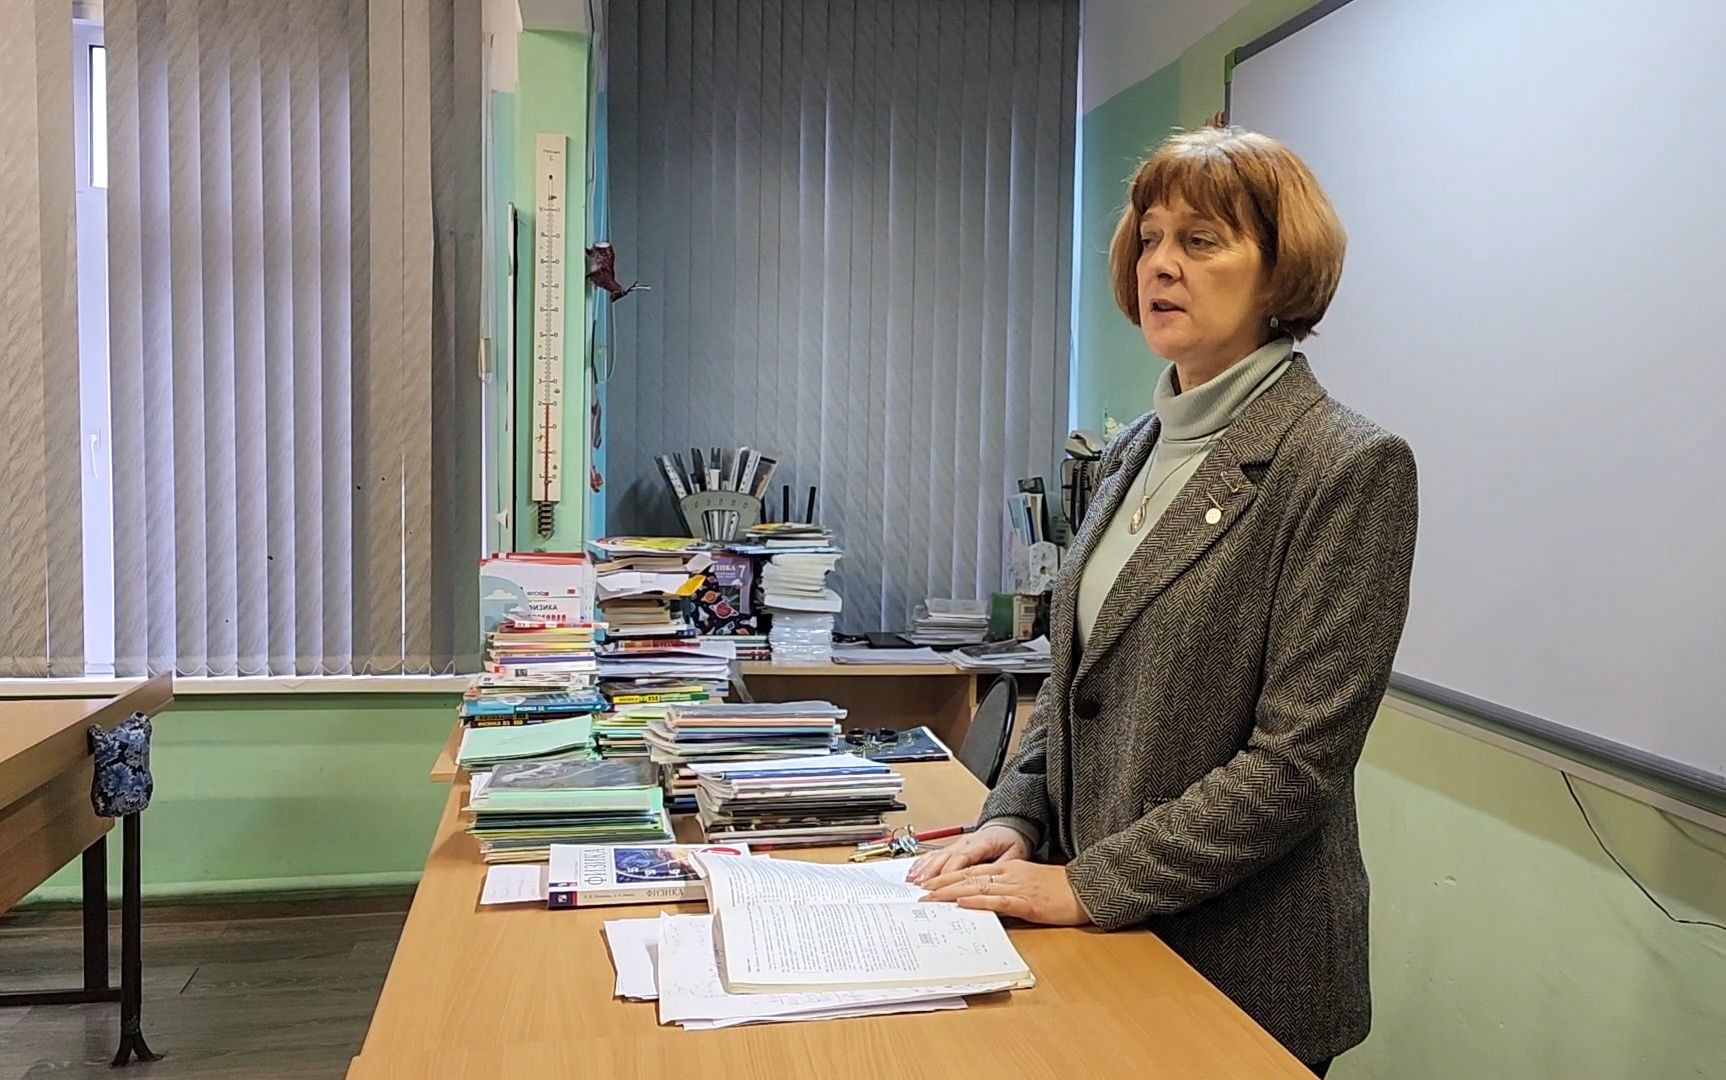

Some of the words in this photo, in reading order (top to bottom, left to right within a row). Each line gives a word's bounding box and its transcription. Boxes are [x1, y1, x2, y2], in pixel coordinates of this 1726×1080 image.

[738, 564, 747, 579] 7
[583, 848, 607, 886] ФИЗИКА
[645, 887, 685, 898] ФИЗИКА
